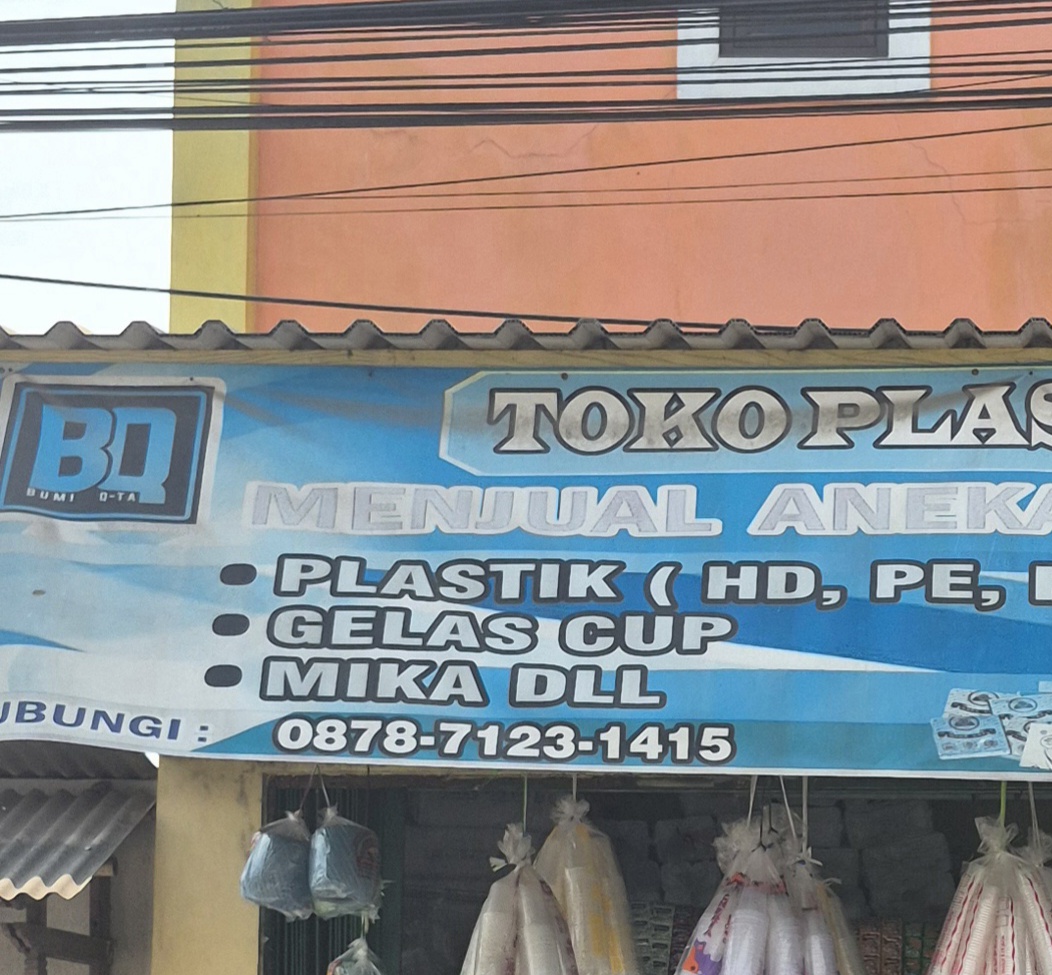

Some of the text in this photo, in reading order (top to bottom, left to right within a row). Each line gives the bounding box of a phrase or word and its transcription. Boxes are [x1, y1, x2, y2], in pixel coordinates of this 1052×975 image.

[487, 385, 792, 455] TOKO
[26, 487, 75, 502] BUMI
[242, 480, 722, 538] MENJUAL
[273, 553, 626, 603] PLASTIK
[702, 561, 847, 611] HD,
[870, 558, 1007, 610] PE,
[266, 604, 737, 656] GELAS CUP
[259, 655, 667, 709] MIKA DLL
[273, 715, 737, 764] 0878-7123-1415
